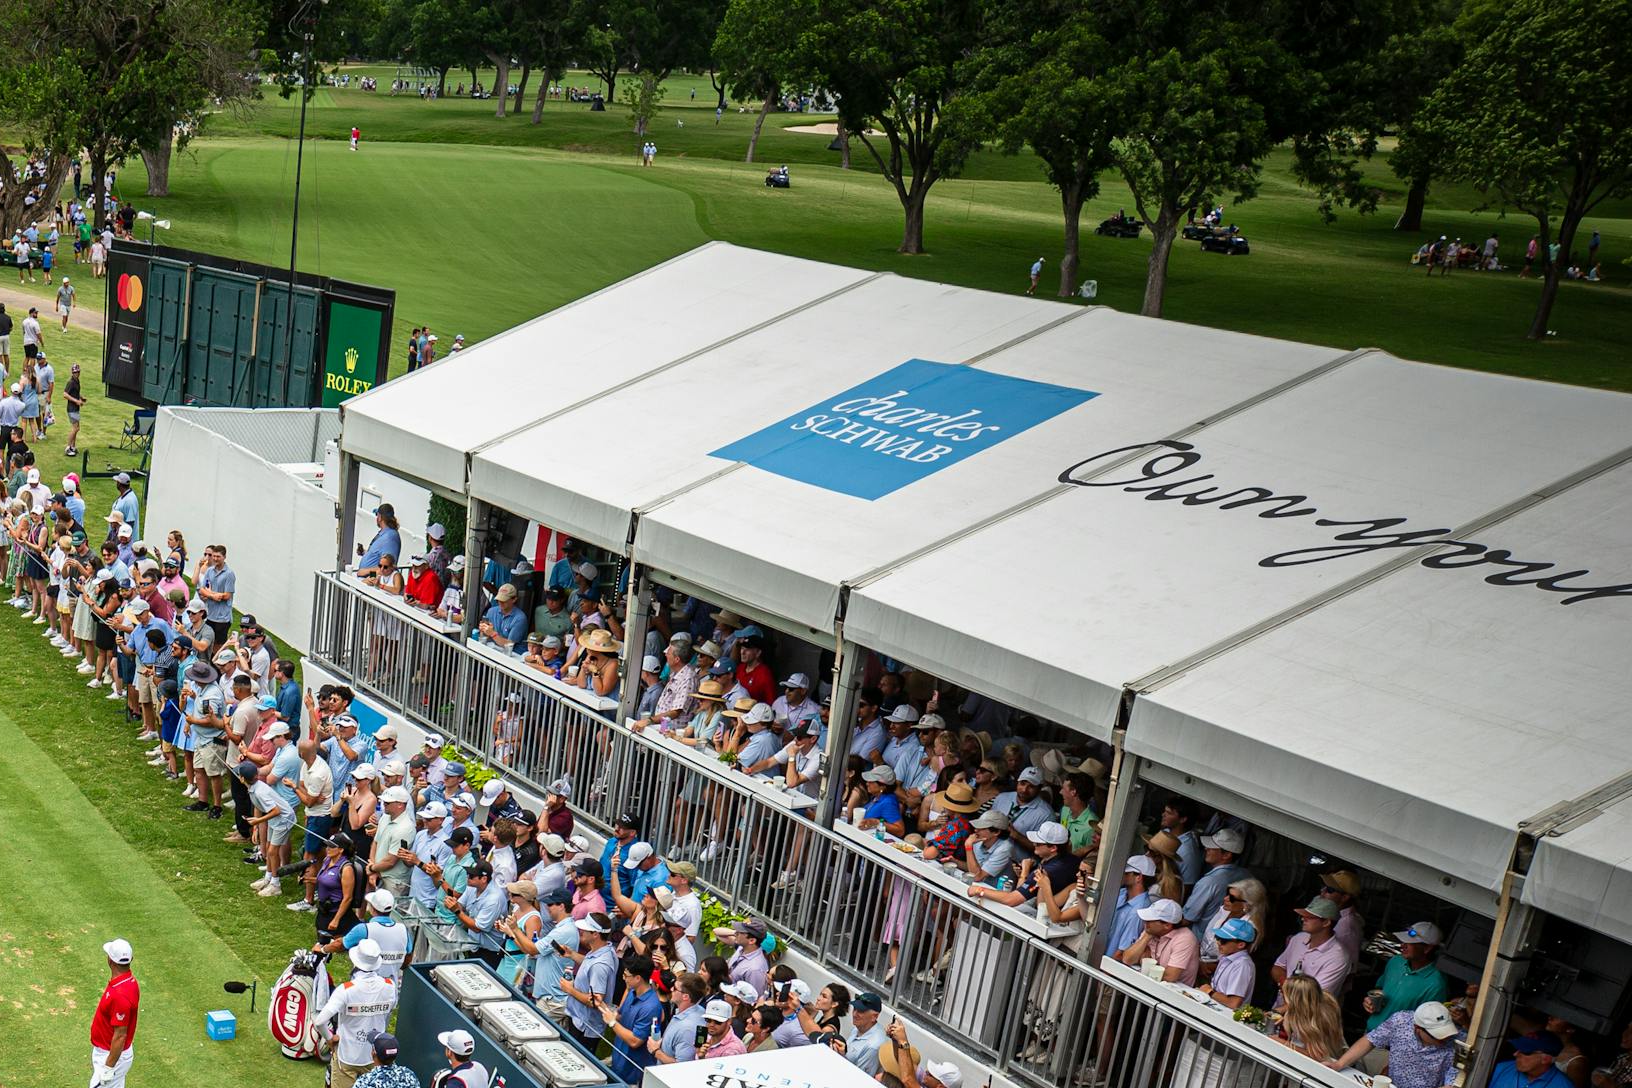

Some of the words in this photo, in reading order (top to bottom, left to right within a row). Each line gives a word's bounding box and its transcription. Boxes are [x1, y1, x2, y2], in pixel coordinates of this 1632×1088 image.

[326, 373, 372, 395] ROLEX
[790, 415, 953, 463] SCHWAB
[832, 390, 1000, 442] charles
[1057, 439, 1317, 519] Own
[283, 989, 301, 1033] CDW
[360, 1003, 390, 1013] SCHEFFLER
